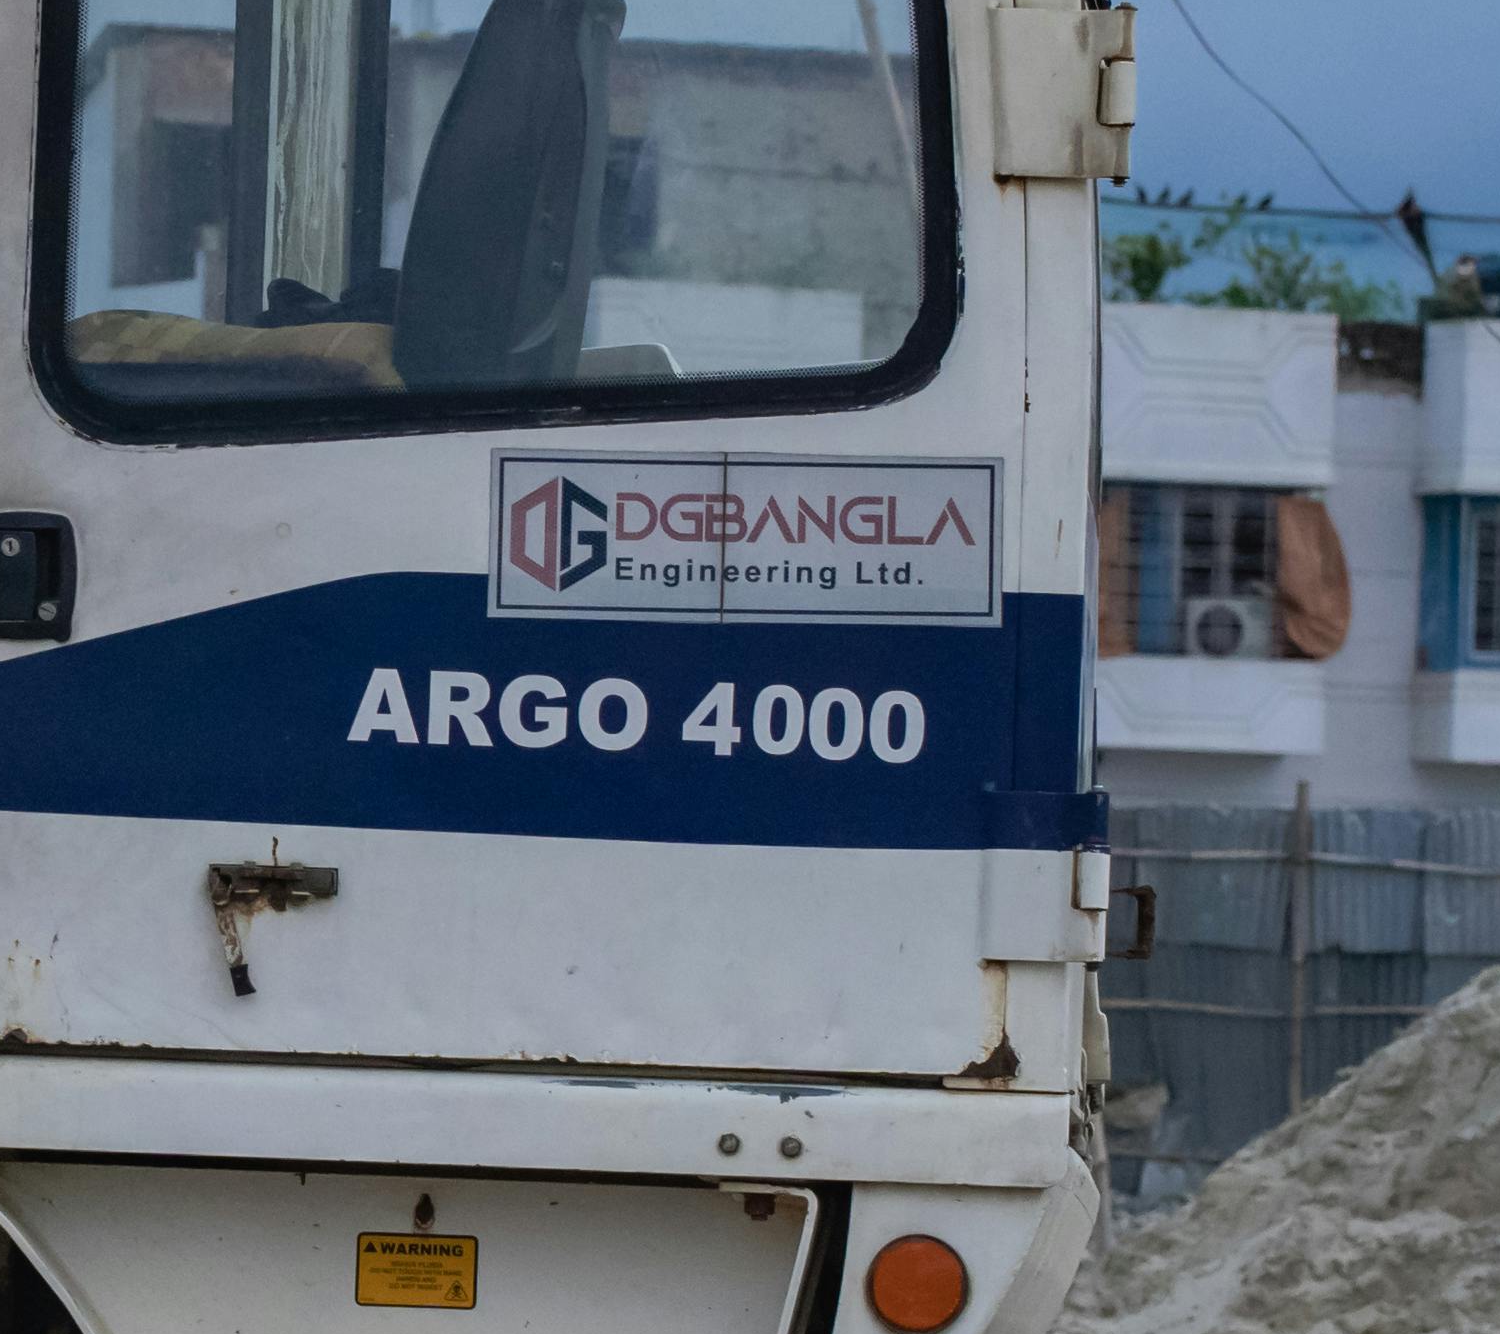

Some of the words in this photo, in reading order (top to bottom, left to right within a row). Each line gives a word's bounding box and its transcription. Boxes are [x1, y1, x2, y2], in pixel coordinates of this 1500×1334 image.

[614, 491, 978, 547] DGBANGLA
[613, 556, 838, 591] Engineering
[855, 560, 926, 587] Ltd.
[346, 667, 649, 752] ARGO
[681, 681, 927, 764] 4000
[380, 1242, 465, 1257] WARNING
